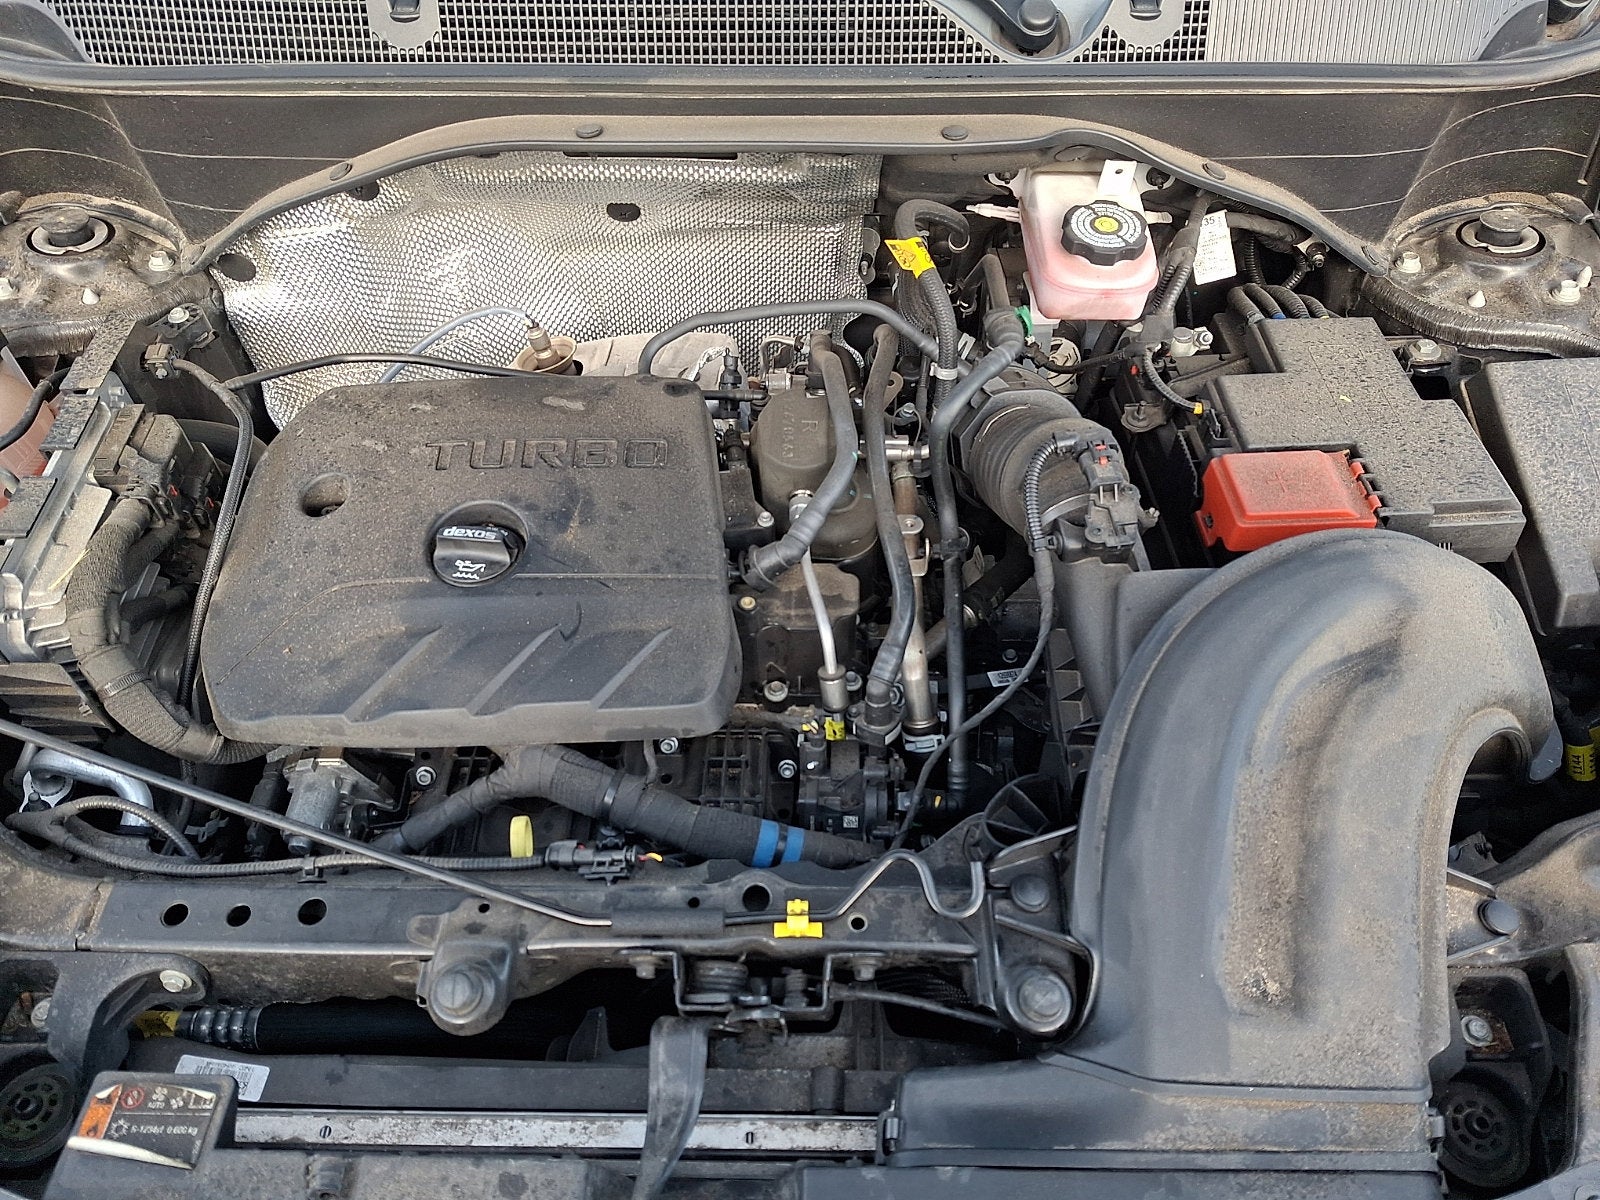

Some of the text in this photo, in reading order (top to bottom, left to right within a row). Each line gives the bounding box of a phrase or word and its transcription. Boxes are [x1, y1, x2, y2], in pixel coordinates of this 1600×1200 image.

[801, 420, 819, 433] R
[425, 437, 668, 470] TURBO
[442, 526, 497, 540] dexos
[147, 1101, 165, 1109] AUTO
